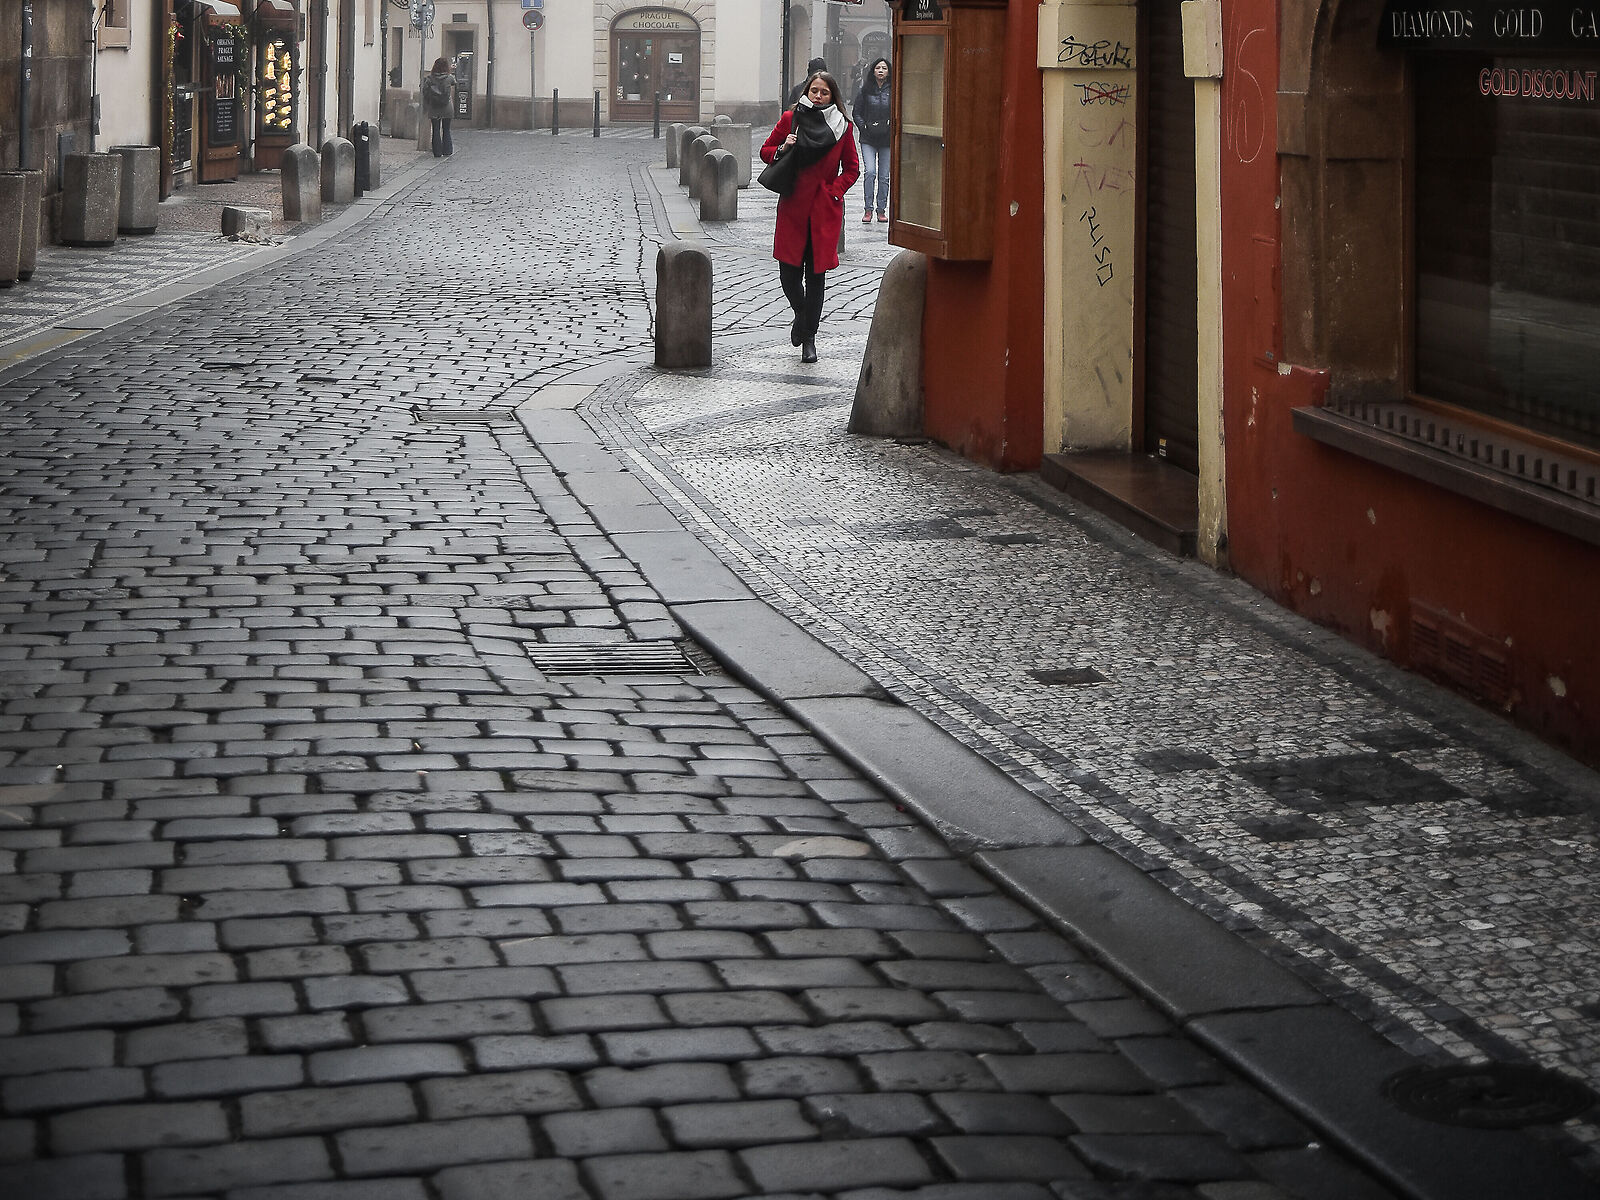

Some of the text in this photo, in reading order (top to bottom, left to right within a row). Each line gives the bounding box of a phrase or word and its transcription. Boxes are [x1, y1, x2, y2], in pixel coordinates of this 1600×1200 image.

[632, 21, 680, 29] CHOCOLATE
[640, 12, 673, 20] PRAGUE
[1392, 10, 1473, 38] DIAMONDS
[1494, 9, 1543, 38] GOLD
[1478, 67, 1598, 101] GOLD DISCOUNT
